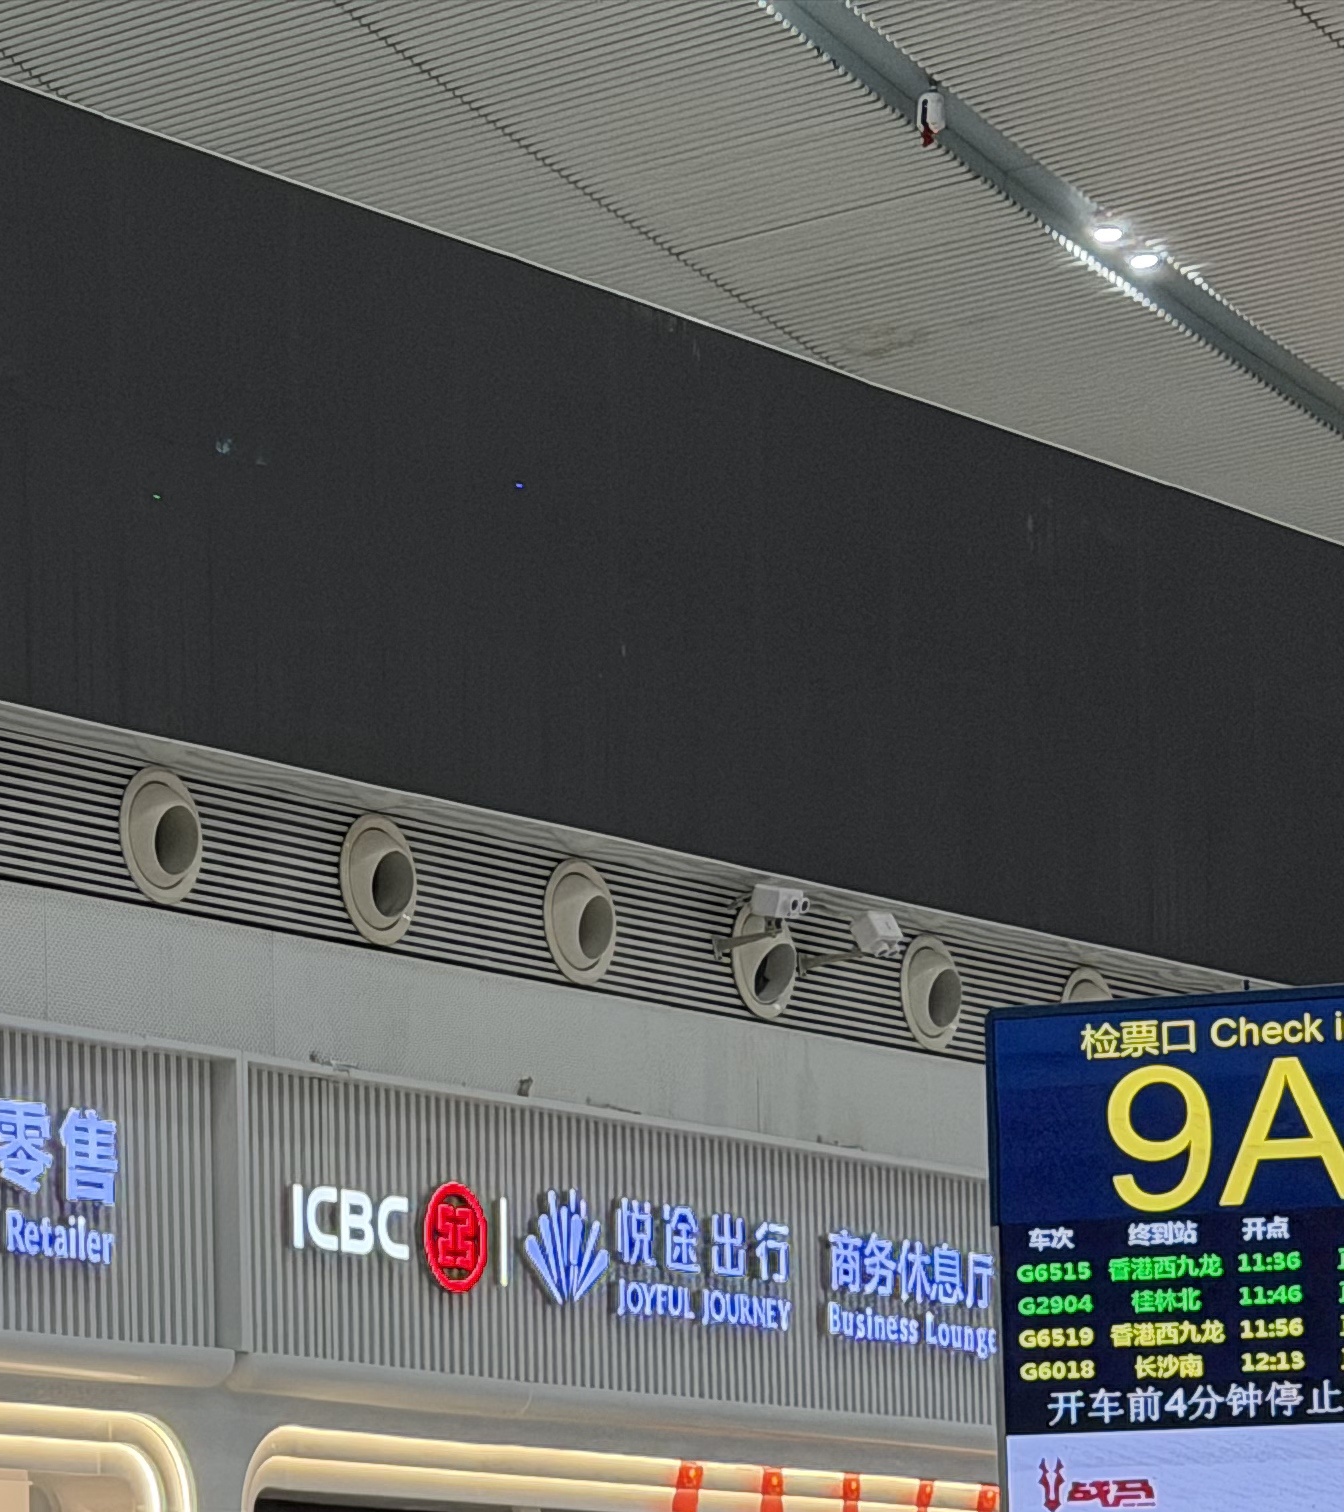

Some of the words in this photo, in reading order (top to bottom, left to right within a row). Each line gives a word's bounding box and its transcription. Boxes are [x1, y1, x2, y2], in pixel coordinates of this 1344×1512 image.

[1080, 1019, 1197, 1060] 检票口
[1210, 1012, 1325, 1048] Check
[1334, 1010, 1344, 1042] i
[1107, 1056, 1344, 1212] 9A
[5, 1208, 116, 1265] Retailer
[291, 1182, 411, 1261] ICBC
[615, 1197, 791, 1284] 悦途出行
[1028, 1227, 1076, 1251] 车次
[1127, 1220, 1199, 1247] 终到站
[1242, 1216, 1291, 1242] 开点
[828, 1229, 996, 1309] 商务休息厅
[1017, 1261, 1092, 1284] G6515
[1108, 1253, 1224, 1282] 香港西九龙
[1237, 1251, 1302, 1273] 11:36
[616, 1278, 696, 1322] JOYFUL
[702, 1289, 793, 1333] JOURNEY
[1018, 1295, 1094, 1317] G2904
[1131, 1287, 1202, 1314] 桂林北
[1238, 1284, 1304, 1308] 11:46
[827, 1301, 920, 1347] Business
[925, 1312, 998, 1361] Lounge
[1018, 1327, 1095, 1349] G6519
[1110, 1320, 1226, 1348] 香港西九龙
[1240, 1318, 1304, 1340] 11:56
[1019, 1359, 1096, 1381] G6018
[1134, 1354, 1204, 1379] 长沙南
[1241, 1351, 1306, 1372] 12:13
